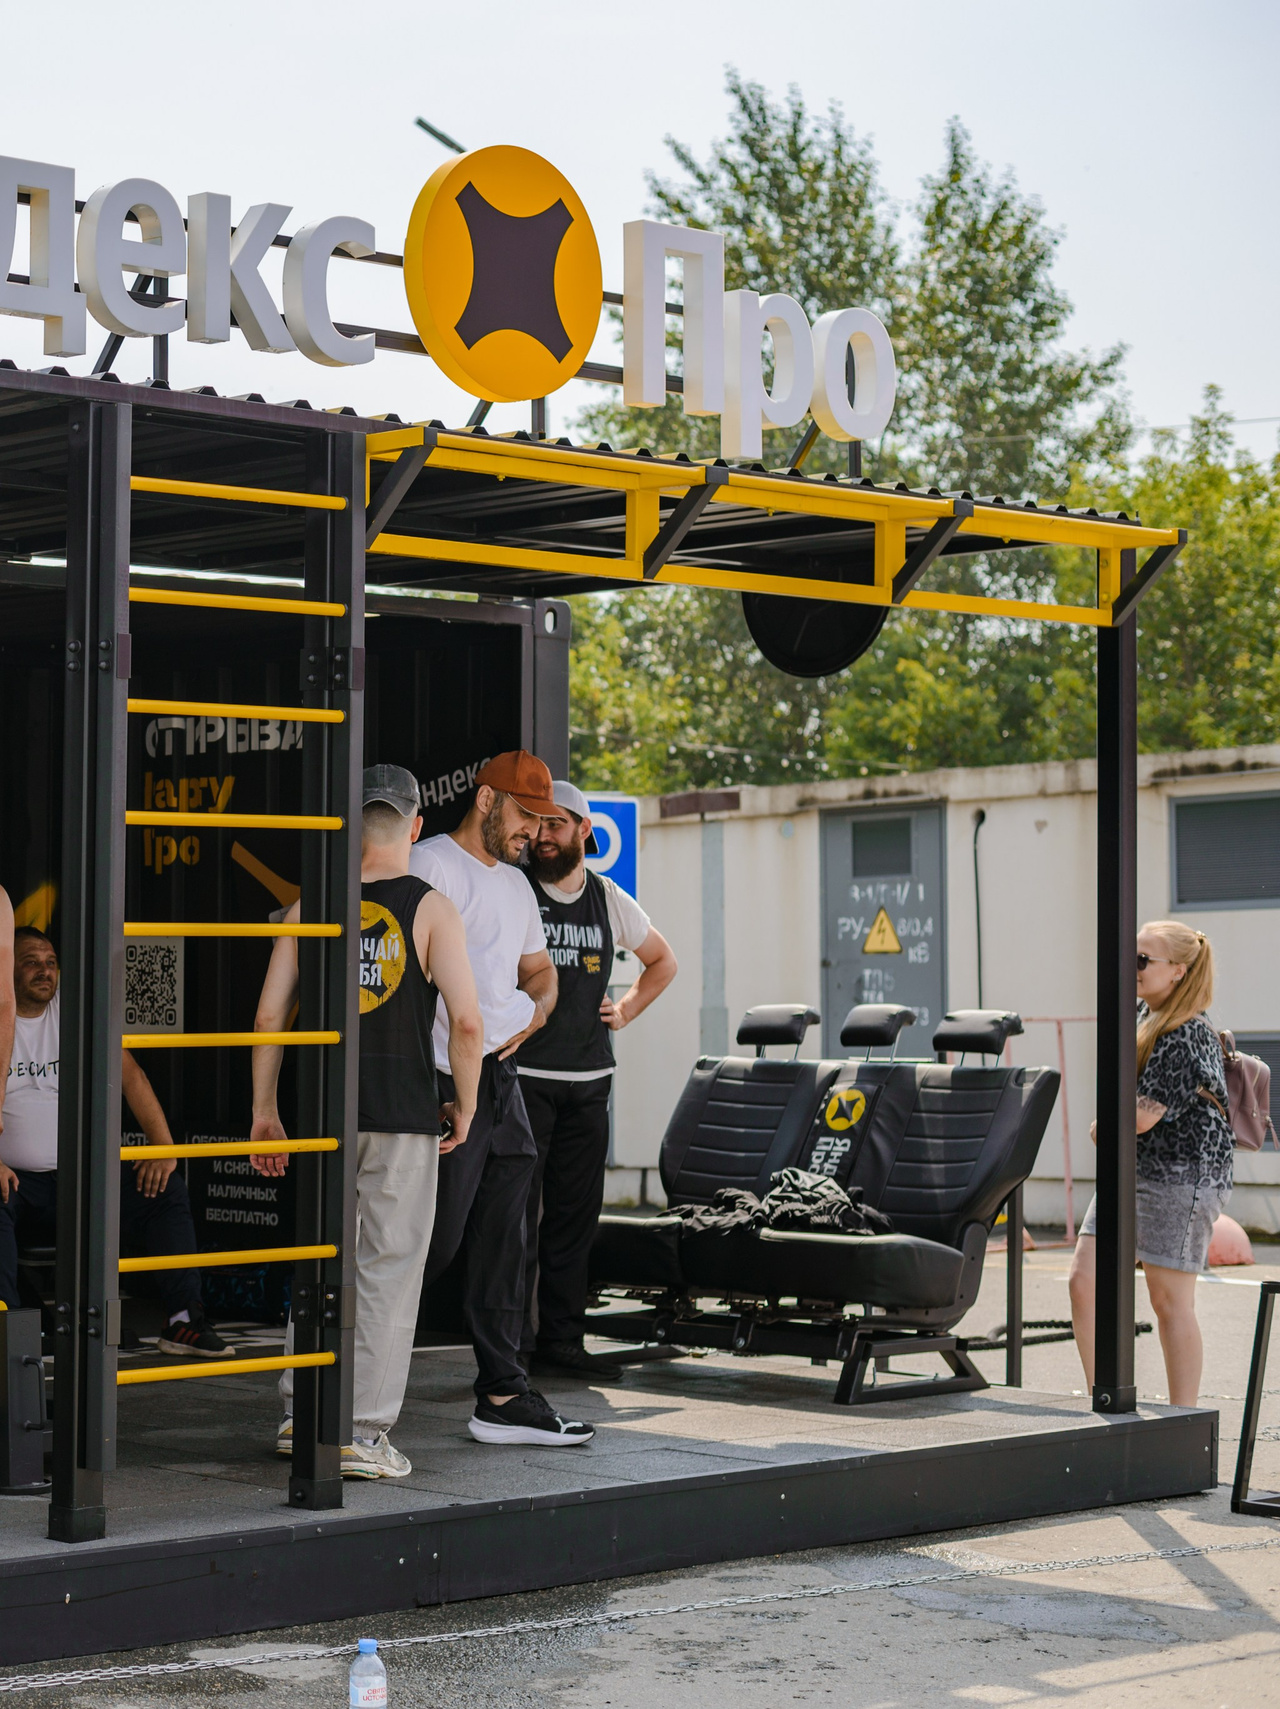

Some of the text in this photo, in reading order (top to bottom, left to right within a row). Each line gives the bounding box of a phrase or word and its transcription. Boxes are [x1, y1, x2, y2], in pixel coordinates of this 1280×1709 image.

[622, 219, 898, 461] Про
[418, 757, 492, 810] ндек
[360, 933, 400, 961] ЧАЙ
[548, 948, 580, 967] ПОРТ
[212, 1159, 261, 1177] И СНЯТ
[207, 1183, 279, 1202] НАЛИЧНЫХ
[205, 1207, 280, 1227] БЕСПЛАТНО
